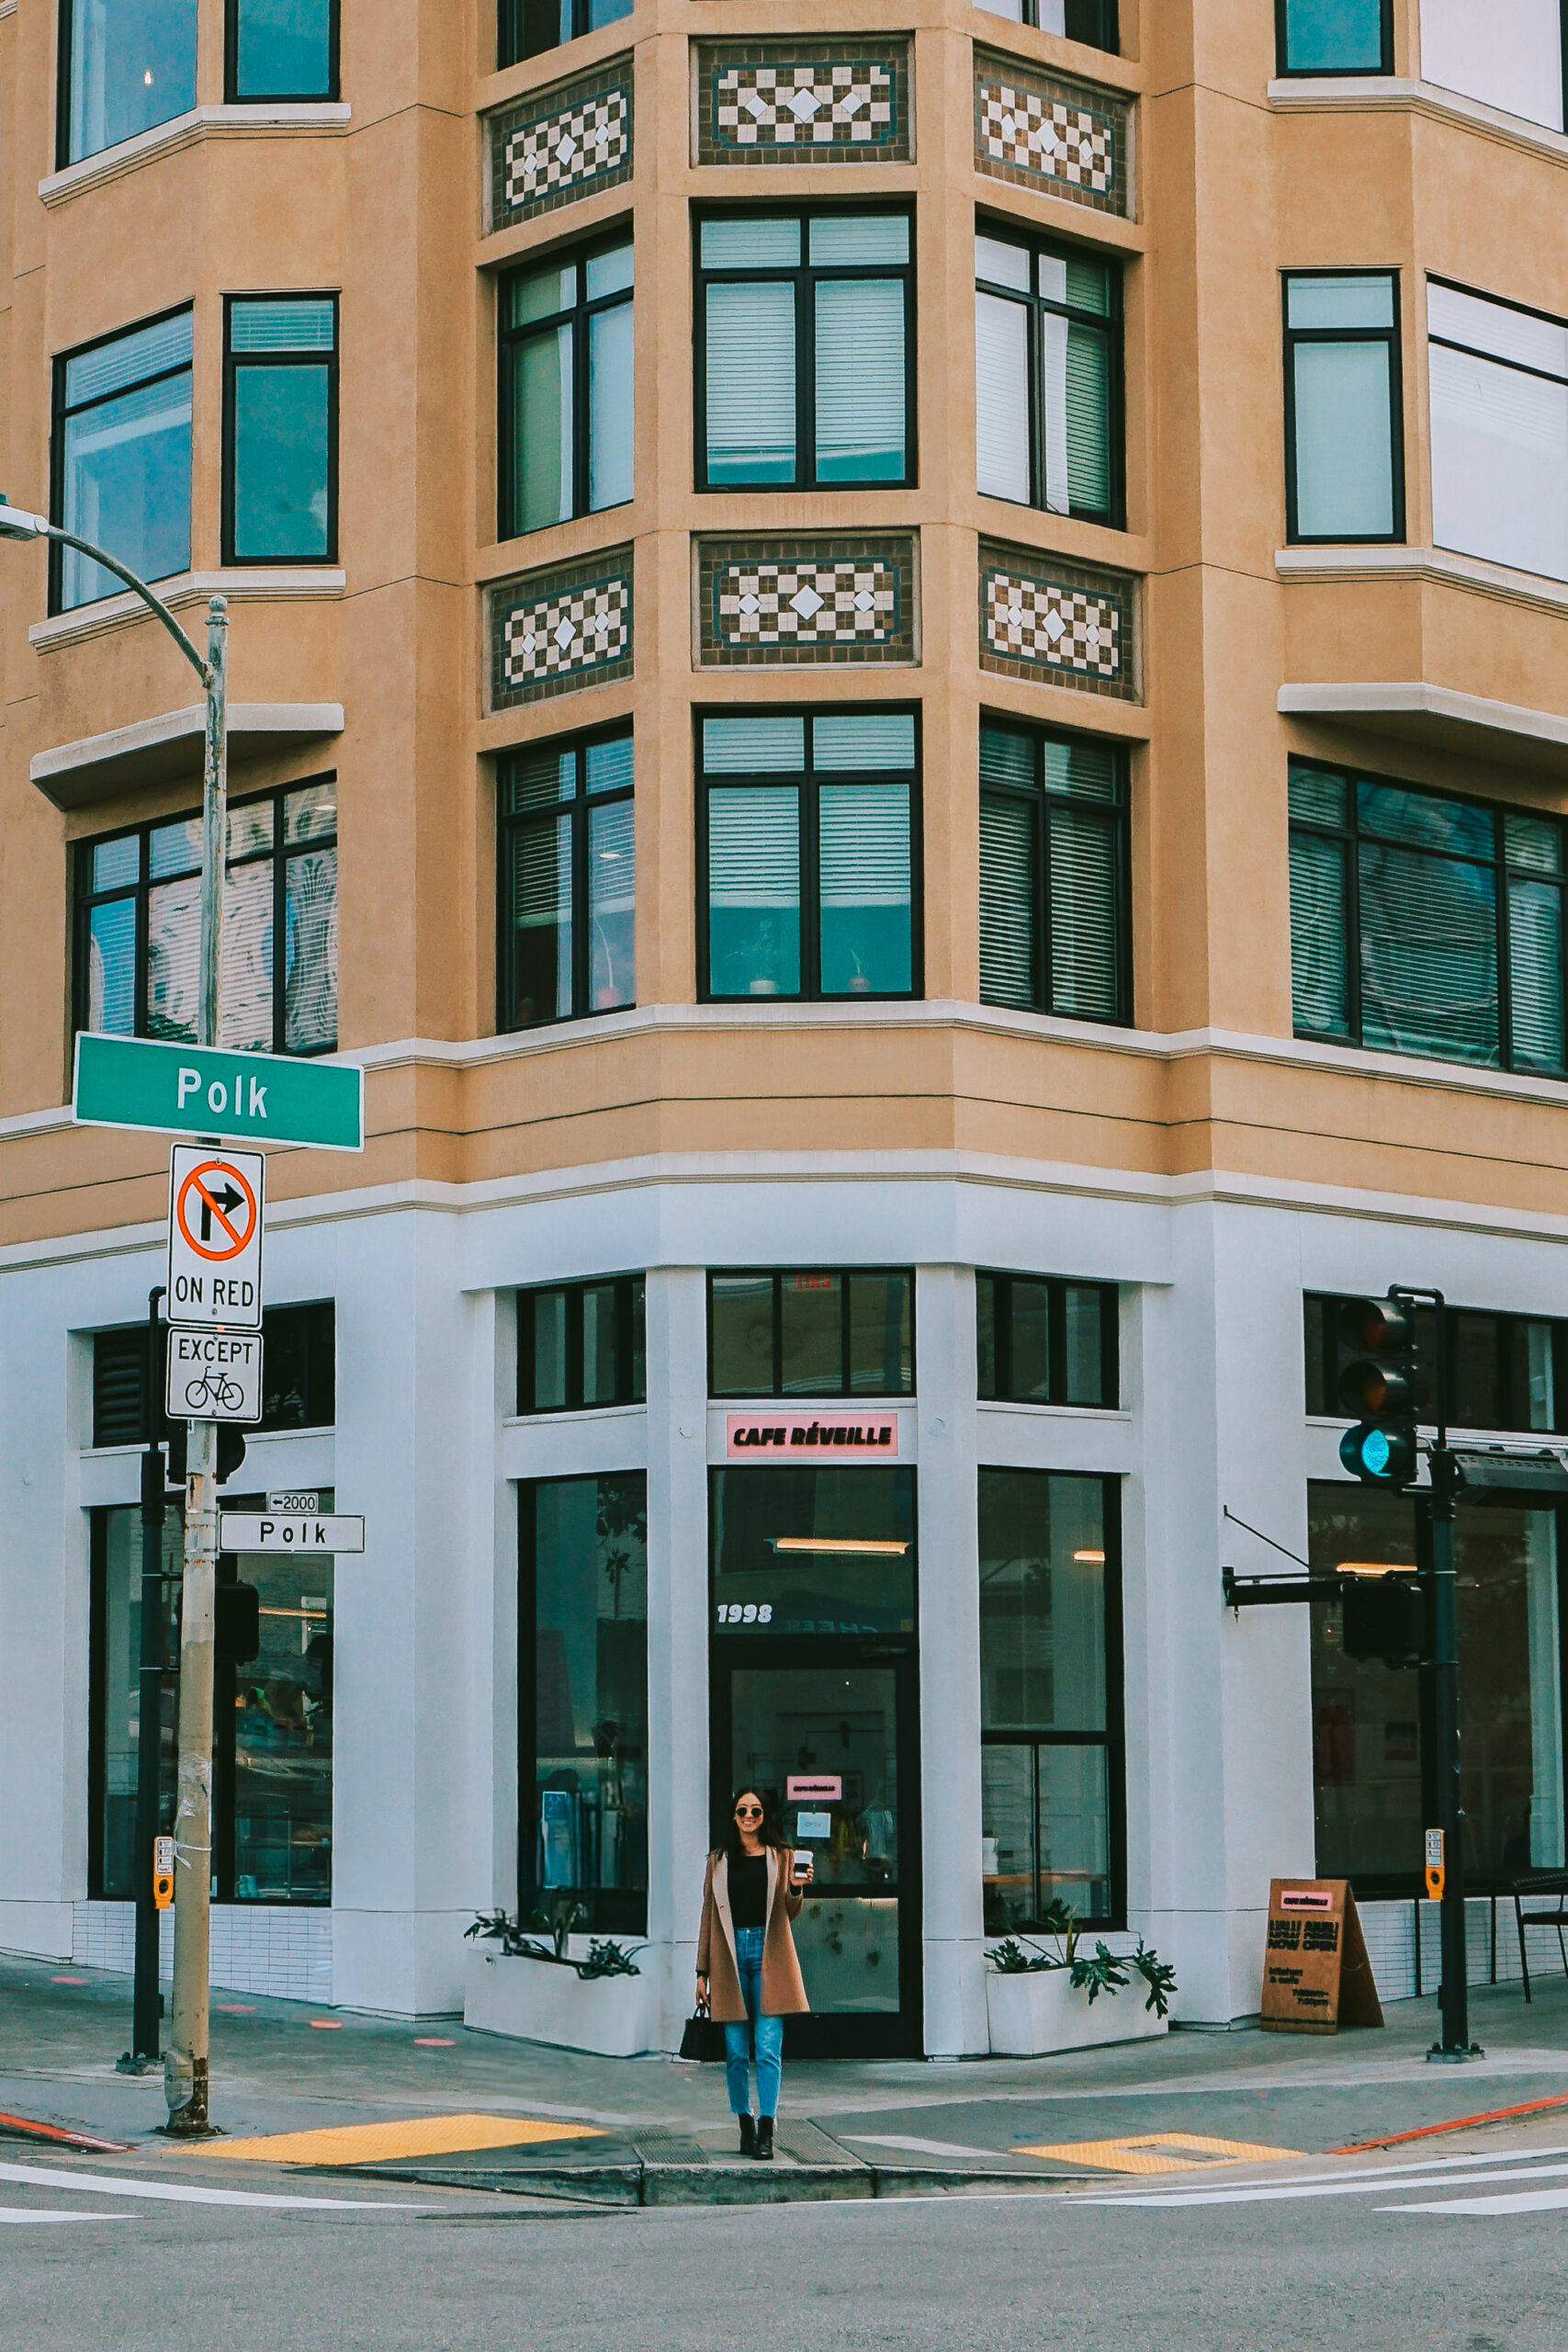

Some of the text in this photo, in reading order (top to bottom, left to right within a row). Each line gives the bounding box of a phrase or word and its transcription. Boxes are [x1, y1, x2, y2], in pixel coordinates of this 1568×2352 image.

[177, 1068, 267, 1118] Polk
[175, 1275, 254, 1307] ON RED
[178, 1338, 254, 1364] EXCEPT
[733, 1421, 892, 1446] CAFE RÉVEILLE
[283, 1496, 315, 1510] 2000
[260, 1521, 326, 1544] Polk
[717, 1604, 773, 1623] 1998
